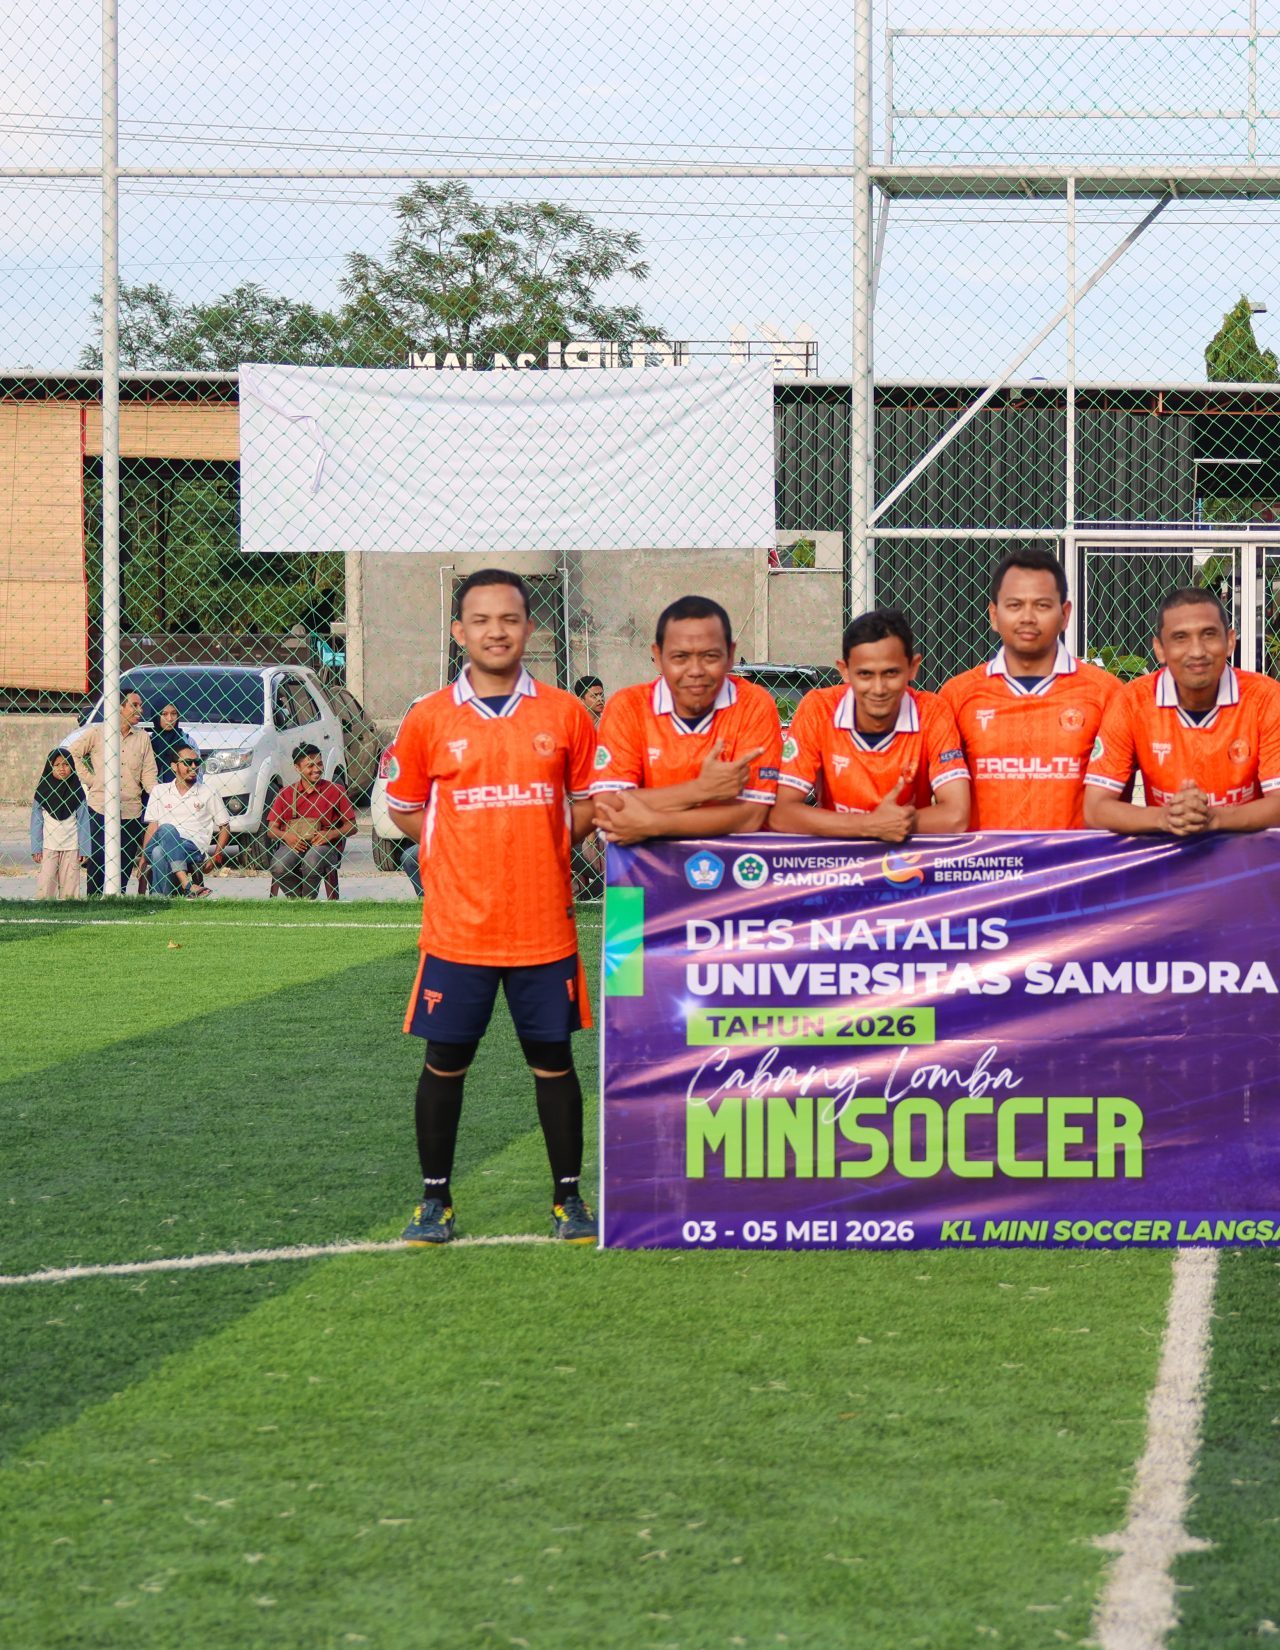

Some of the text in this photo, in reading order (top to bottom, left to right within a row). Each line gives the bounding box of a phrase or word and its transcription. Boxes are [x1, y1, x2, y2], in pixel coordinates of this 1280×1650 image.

[976, 757, 1080, 773] FACULTY
[452, 782, 554, 804] FACULTY
[773, 857, 865, 868] UNIVERSITAS
[934, 857, 1024, 868] DIKTISAINTEK
[773, 873, 865, 886] SAMUDRA
[934, 870, 1024, 882] BERDAMPAK
[686, 917, 1010, 951] DIES NATALIS
[686, 962, 1012, 996] UNIVERSITAS
[1024, 961, 1279, 994] SAMUDRA
[706, 1014, 917, 1038] TAHUN 2026
[685, 1045, 1024, 1125] Cabang Lomba
[681, 1220, 717, 1243] 03
[742, 1220, 779, 1243] 05
[786, 1220, 838, 1243] MEI
[847, 1220, 915, 1243] 2026
[940, 1220, 977, 1242] KL
[983, 1220, 1048, 1242] MINI
[1054, 1220, 1171, 1242] SOCCER
